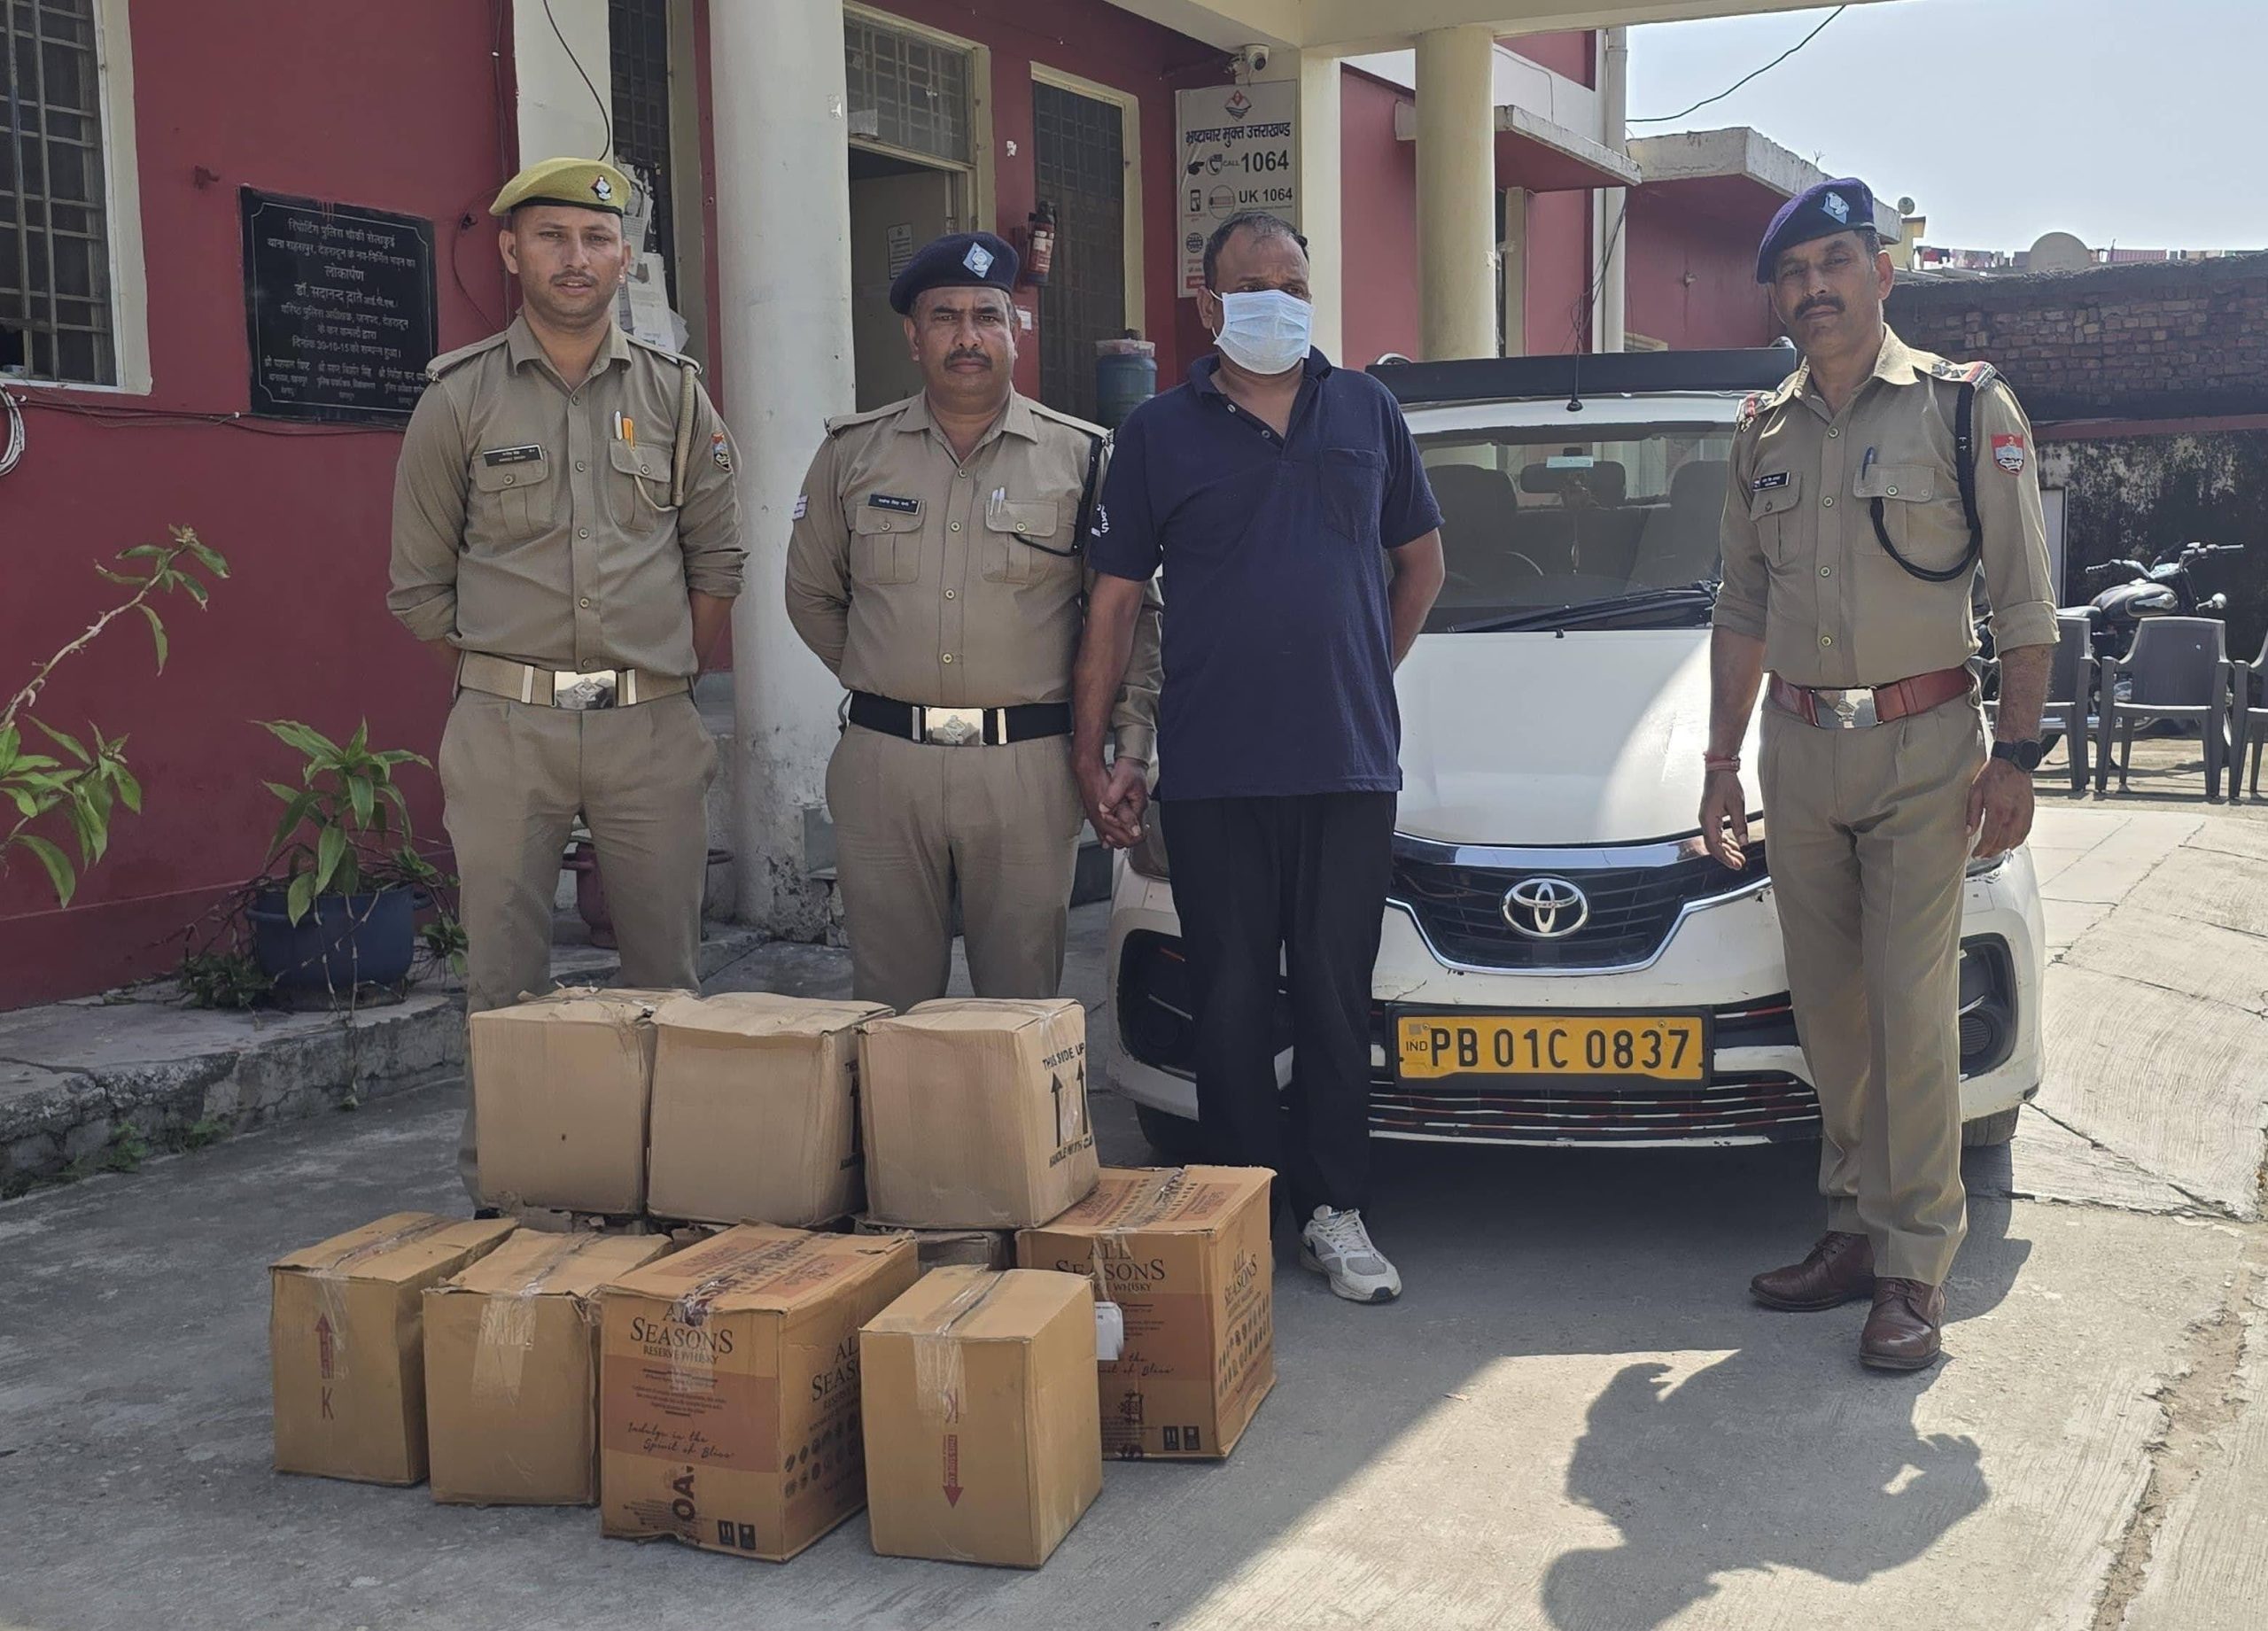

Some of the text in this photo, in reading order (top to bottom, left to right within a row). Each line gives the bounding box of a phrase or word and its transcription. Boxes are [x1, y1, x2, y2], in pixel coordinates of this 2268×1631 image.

[1223, 127, 1244, 148] मुक्त
[1247, 122, 1291, 139] उत्तराखण्ड
[1241, 150, 1289, 173] 1064
[1239, 187, 1293, 204] UK 1064
[324, 263, 364, 282] लोकार्पण
[1056, 1047, 1075, 1064] SIDE
[1075, 1042, 1084, 1055] UP
[1406, 1028, 1689, 1068] IND PB 01C 0837
[1114, 1282, 1152, 1292] WHISKY
[631, 1316, 734, 1354] SEASONS
[690, 1431, 710, 1442] the
